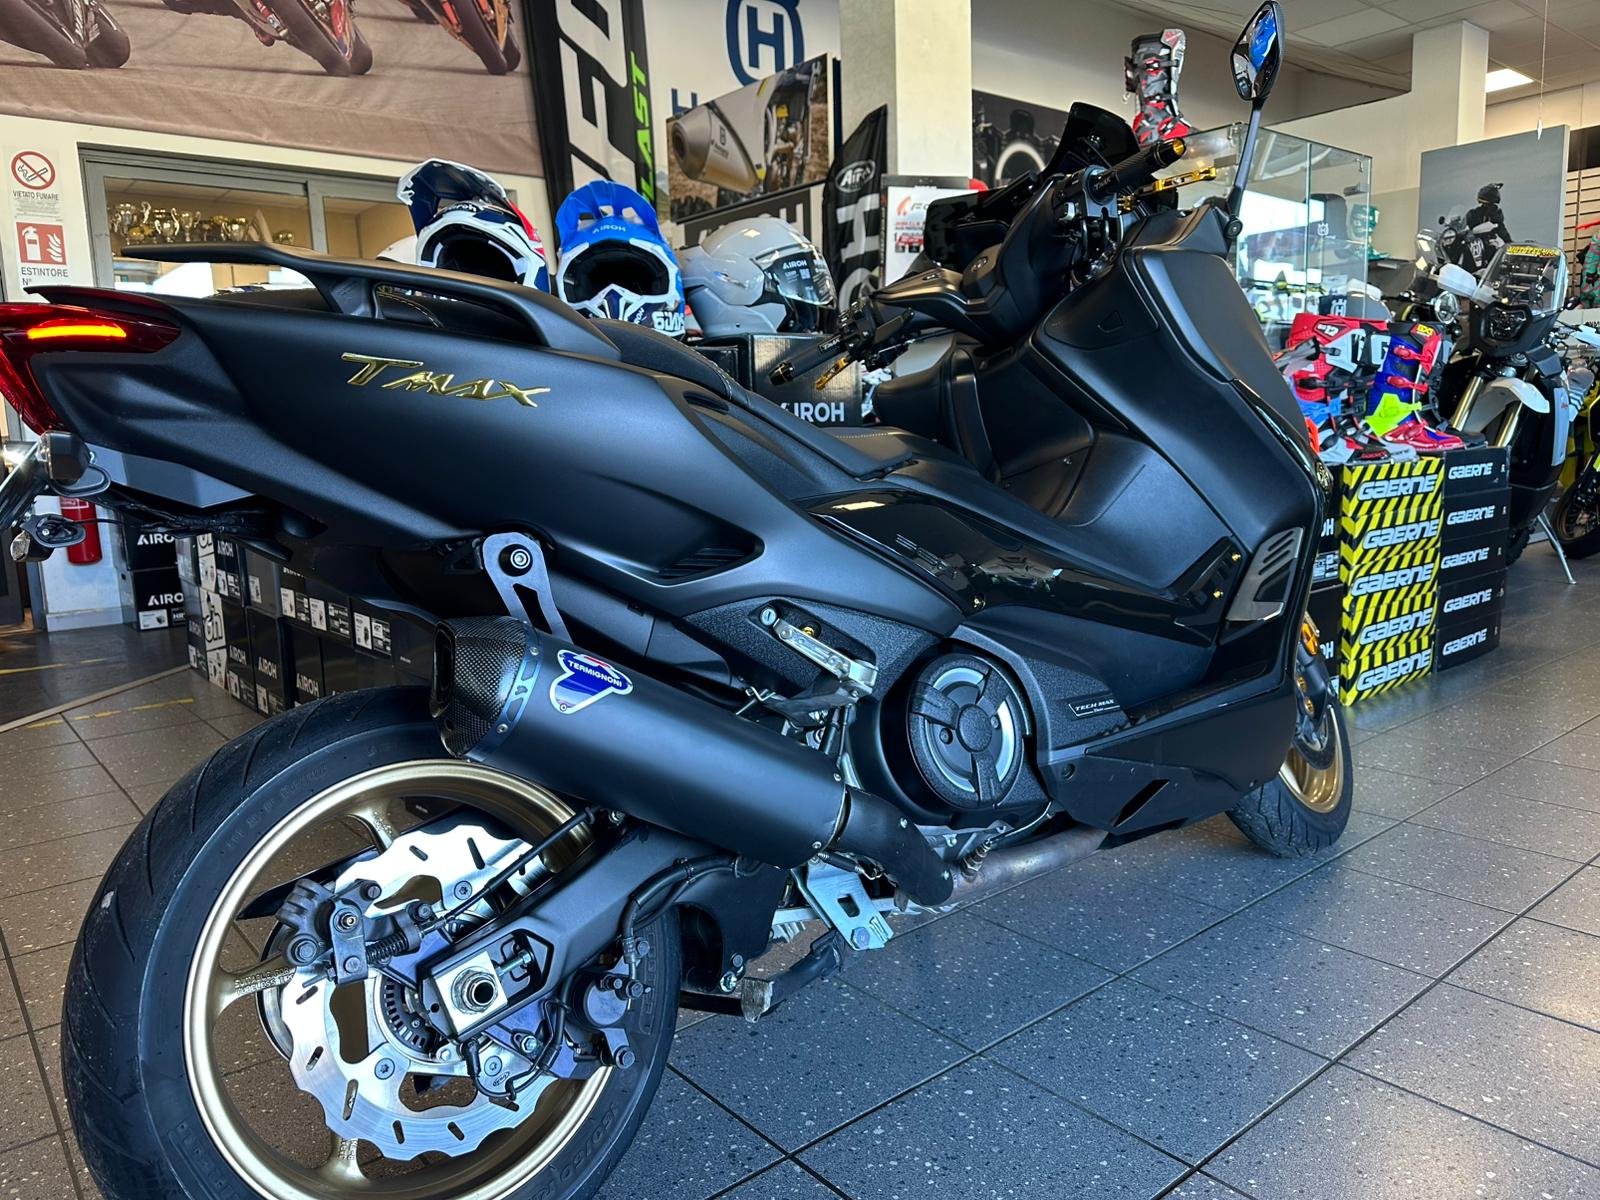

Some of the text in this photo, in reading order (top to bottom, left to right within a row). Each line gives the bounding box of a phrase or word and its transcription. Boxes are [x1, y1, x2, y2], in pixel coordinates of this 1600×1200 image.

[630, 51, 656, 202] LAST
[13, 189, 59, 201] VIETATO FUMARE
[21, 266, 69, 278] ESTINTORE
[783, 259, 808, 270] AIROH
[341, 352, 551, 408] TMAX
[1448, 461, 1493, 480] GAERNE
[1357, 473, 1438, 501] GAERNE
[1446, 505, 1496, 526] GAERNE
[137, 533, 175, 546] AIRO
[1362, 518, 1440, 550] GAERNE
[1440, 546, 1490, 569] GAERNE
[1351, 563, 1434, 597] GAERNE
[148, 592, 184, 606] AIRO
[1443, 587, 1493, 614] GAERNE
[1359, 607, 1433, 645] GAERNE
[1442, 627, 1488, 656] GAERNE
[258, 656, 278, 679] AIROH
[567, 659, 623, 688] TERMIGNONI
[1356, 648, 1432, 692] GAERNE
[296, 673, 320, 699] AIROH
[1075, 702, 1097, 712] TECH
[1098, 699, 1114, 708] MAX
